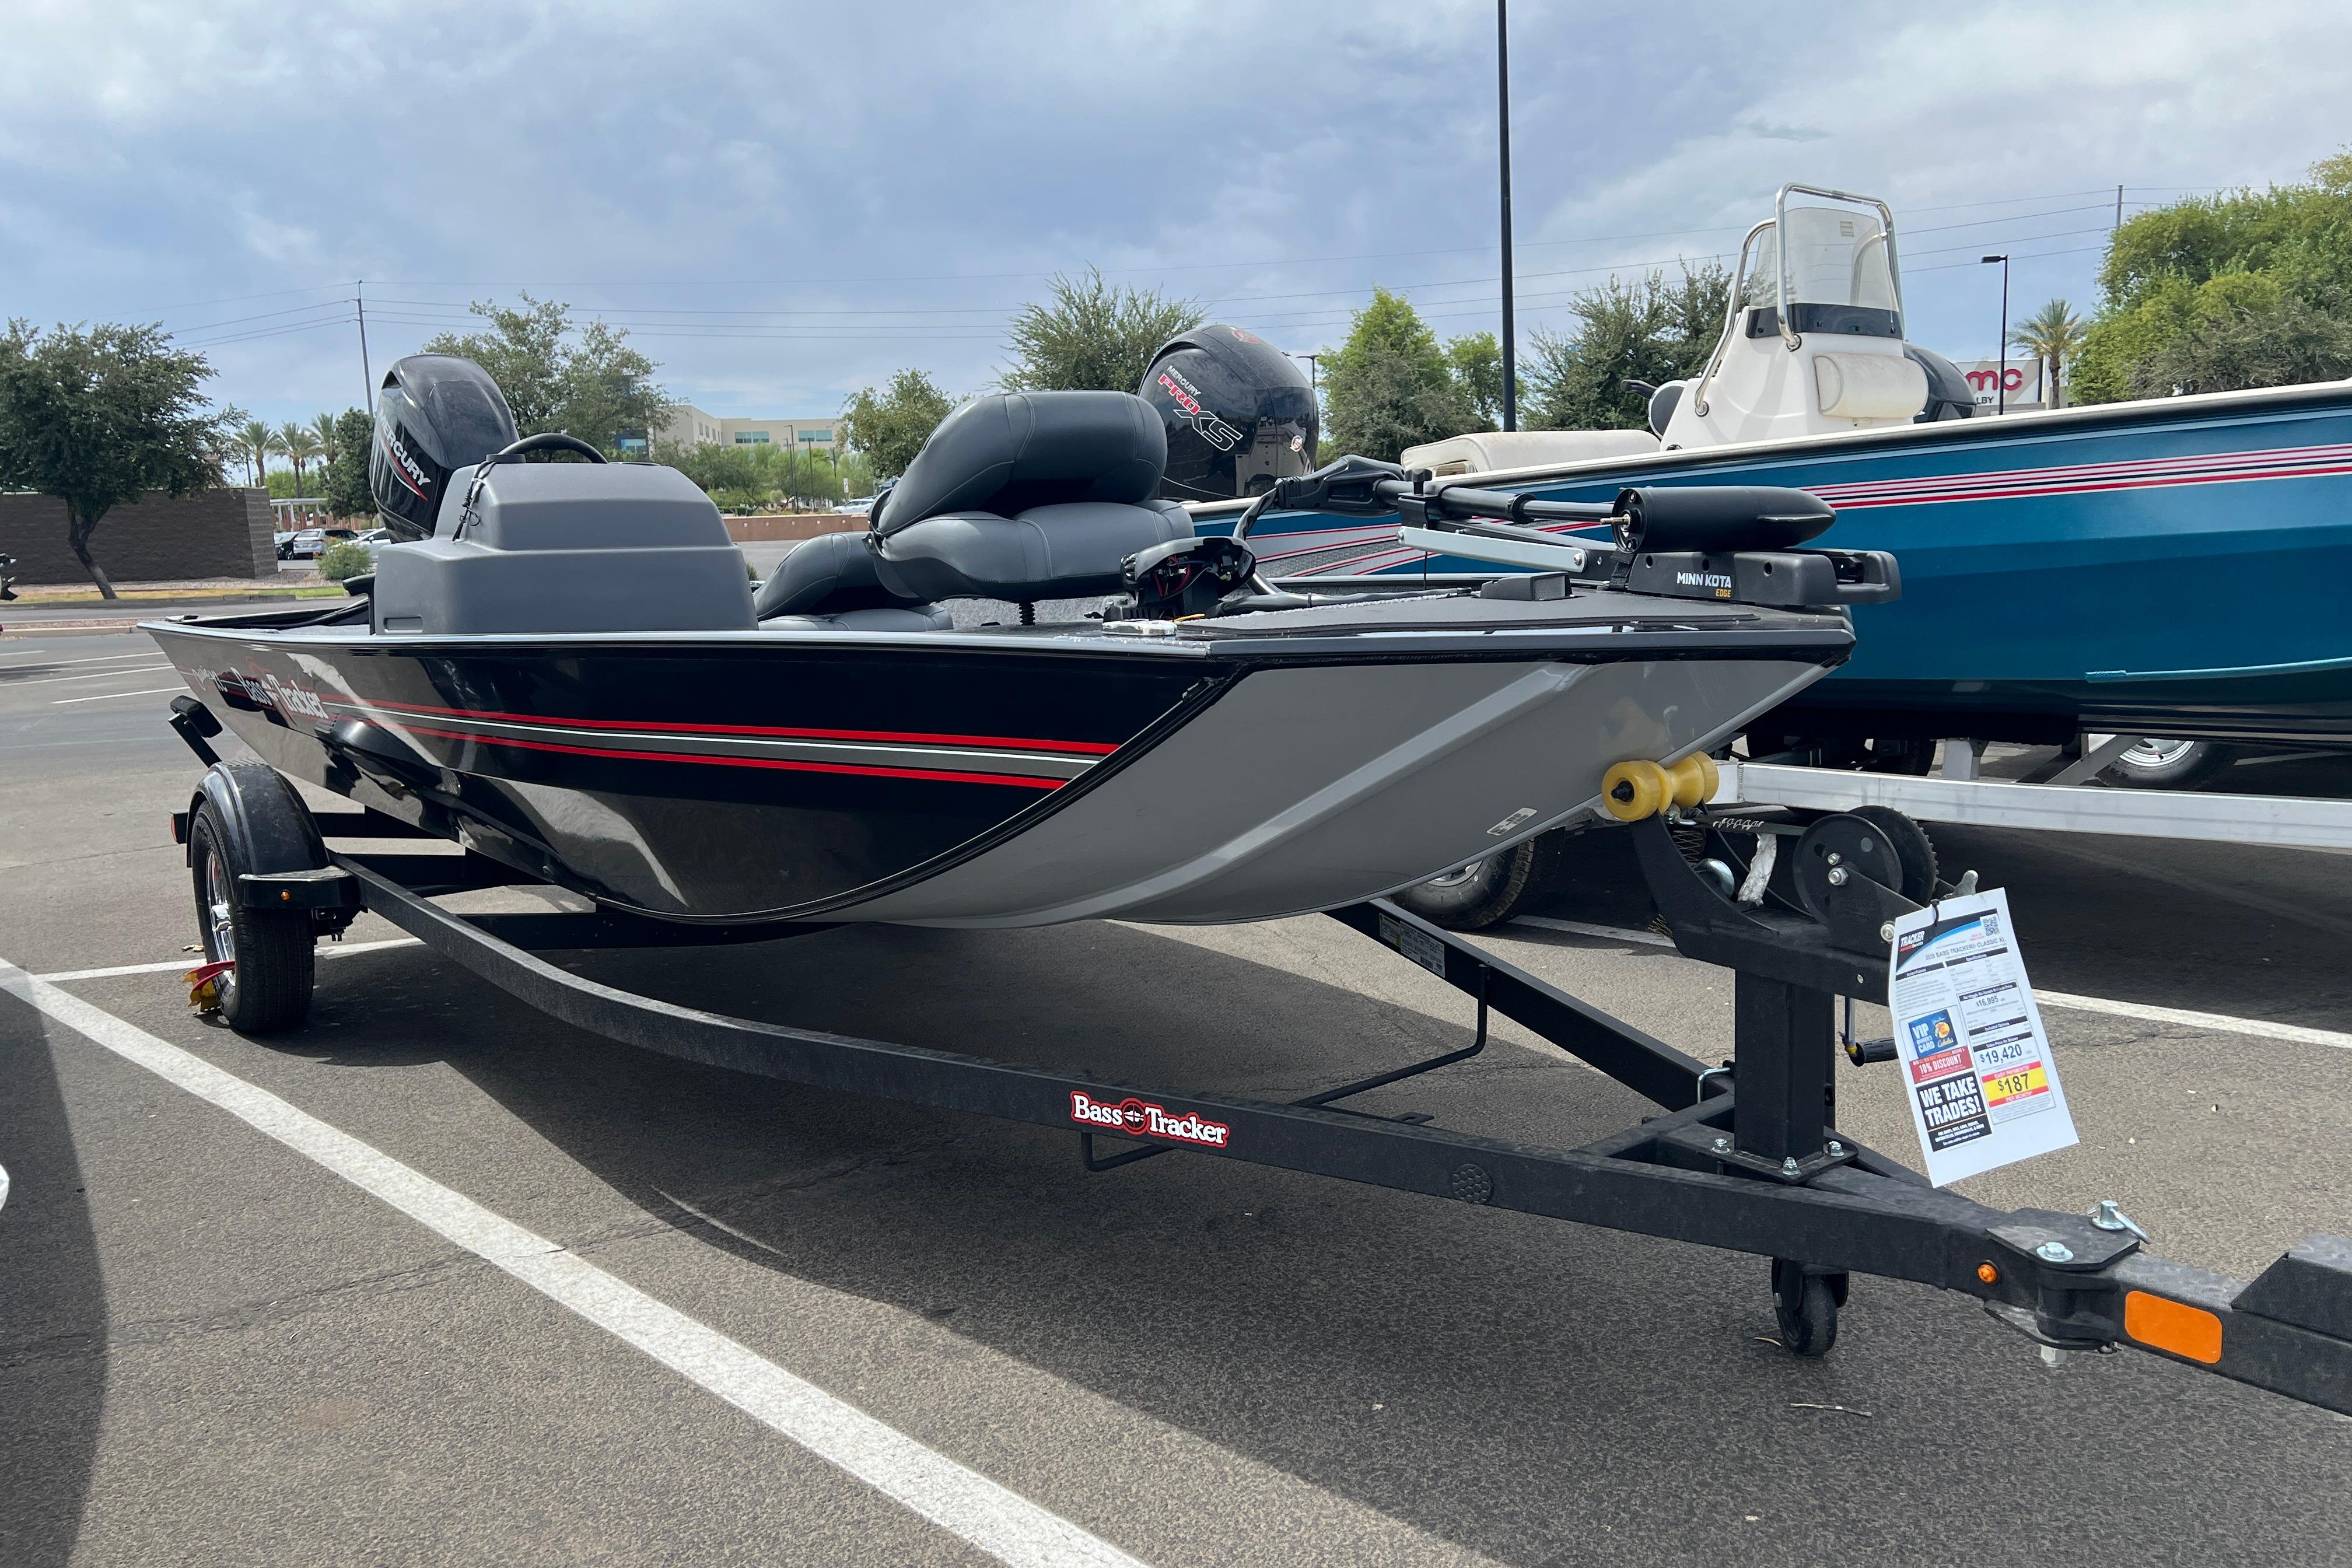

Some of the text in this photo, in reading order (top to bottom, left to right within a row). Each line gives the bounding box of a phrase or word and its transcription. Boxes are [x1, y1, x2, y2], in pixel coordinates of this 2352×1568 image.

[1167, 365, 1201, 397] MERCURY
[1965, 369, 2022, 391] mc
[1157, 373, 1201, 415] PRO
[1976, 396, 1994, 404] LBY
[1172, 409, 1244, 451] XS
[379, 408, 431, 486] MERCURY
[1676, 572, 1732, 588] MINN KOTA
[1715, 588, 1732, 598] EDGE
[230, 667, 272, 706] Bass
[265, 673, 328, 719] Tracker
[1901, 930, 1925, 948] TRACKER
[1977, 939, 1998, 948] CLASSIC
[1976, 995, 1999, 1007] $16,995
[1912, 1023, 1929, 1039] VIP
[1918, 1041, 1935, 1053] CARD
[1980, 1044, 2022, 1064] $19,420
[1919, 1062, 1933, 1074] 10%
[1932, 1054, 1962, 1070] DISCOUNT
[1919, 1076, 1978, 1108] WE TAKE
[1998, 1073, 2028, 1094] $187
[1073, 1094, 1226, 1144] Bass Tracker
[1924, 1094, 1982, 1127] TRADES!
